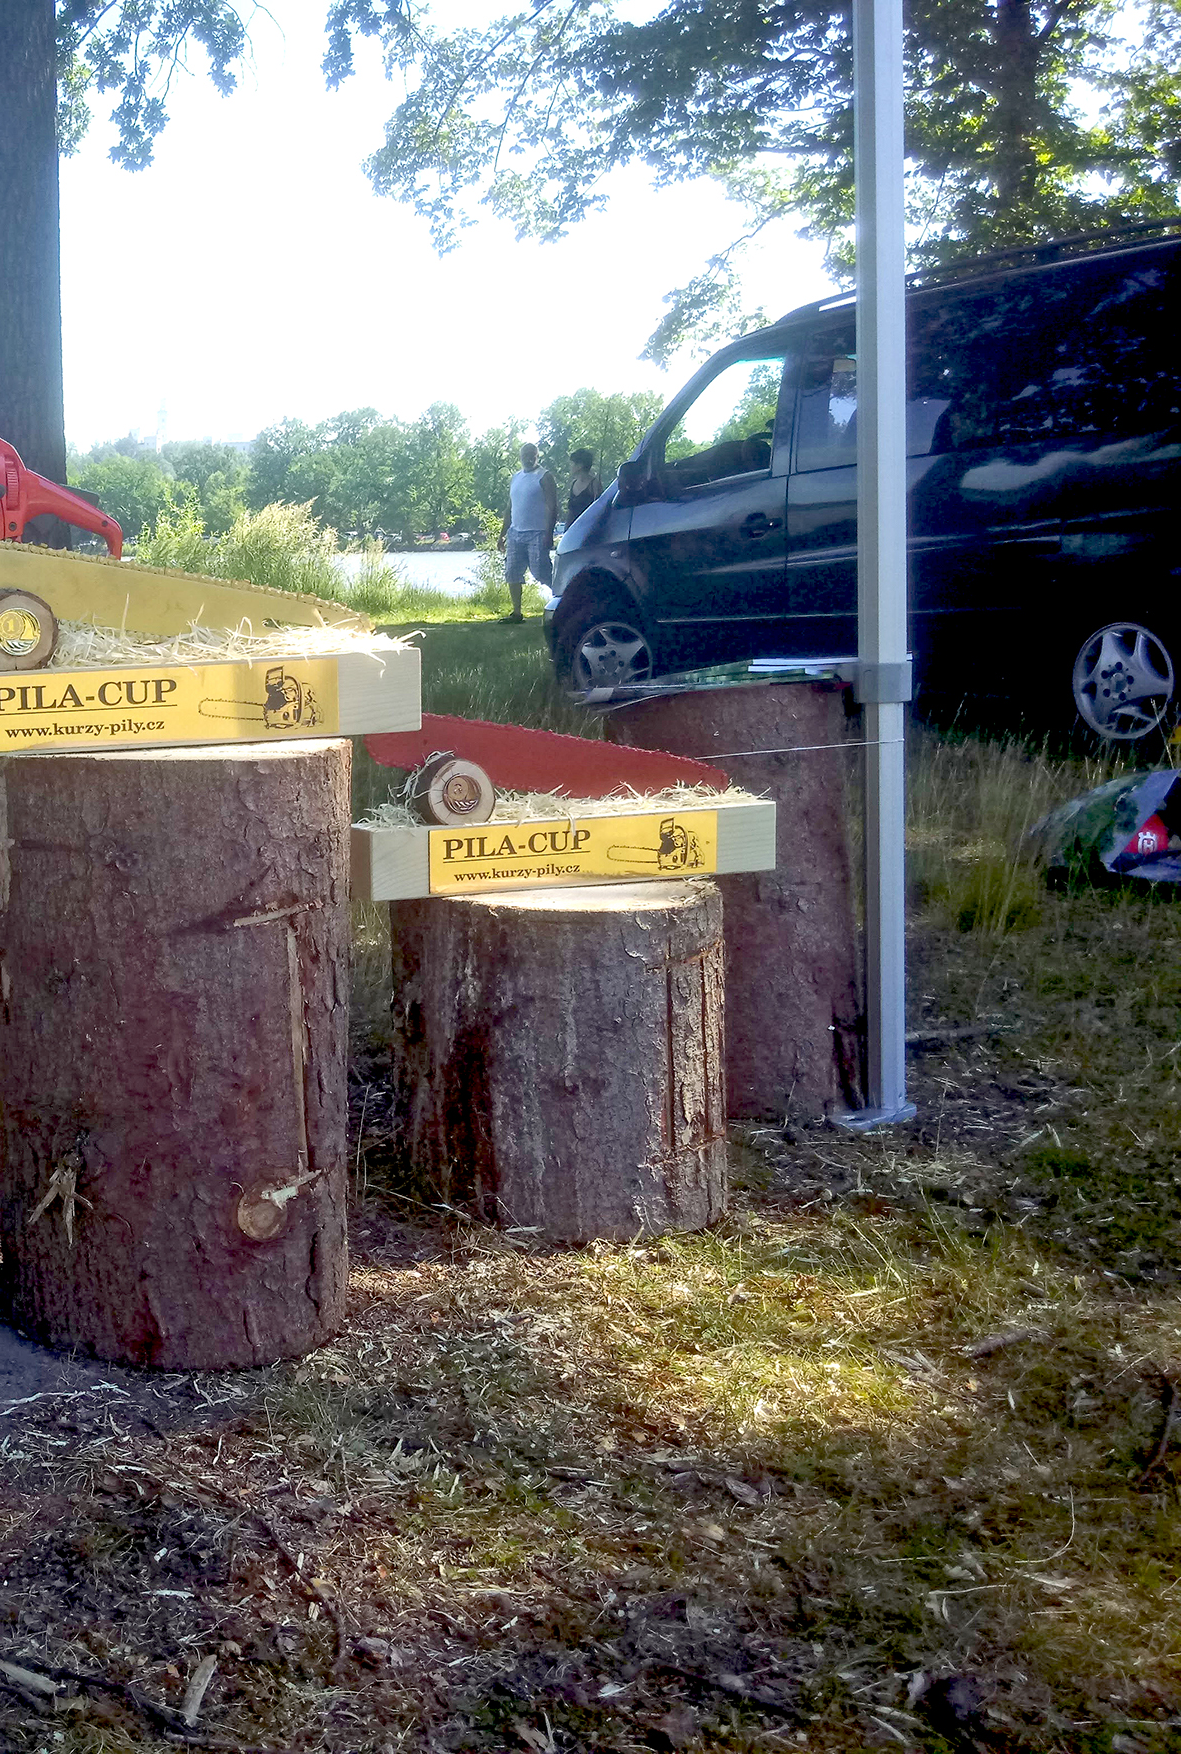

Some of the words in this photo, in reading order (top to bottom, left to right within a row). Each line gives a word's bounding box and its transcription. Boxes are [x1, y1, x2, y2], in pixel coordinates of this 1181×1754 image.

[4, 719, 165, 738] www.kurzy-pily.cz
[442, 829, 591, 860] PILA-CUP
[453, 863, 580, 882] www.kurzy-pily.cz
